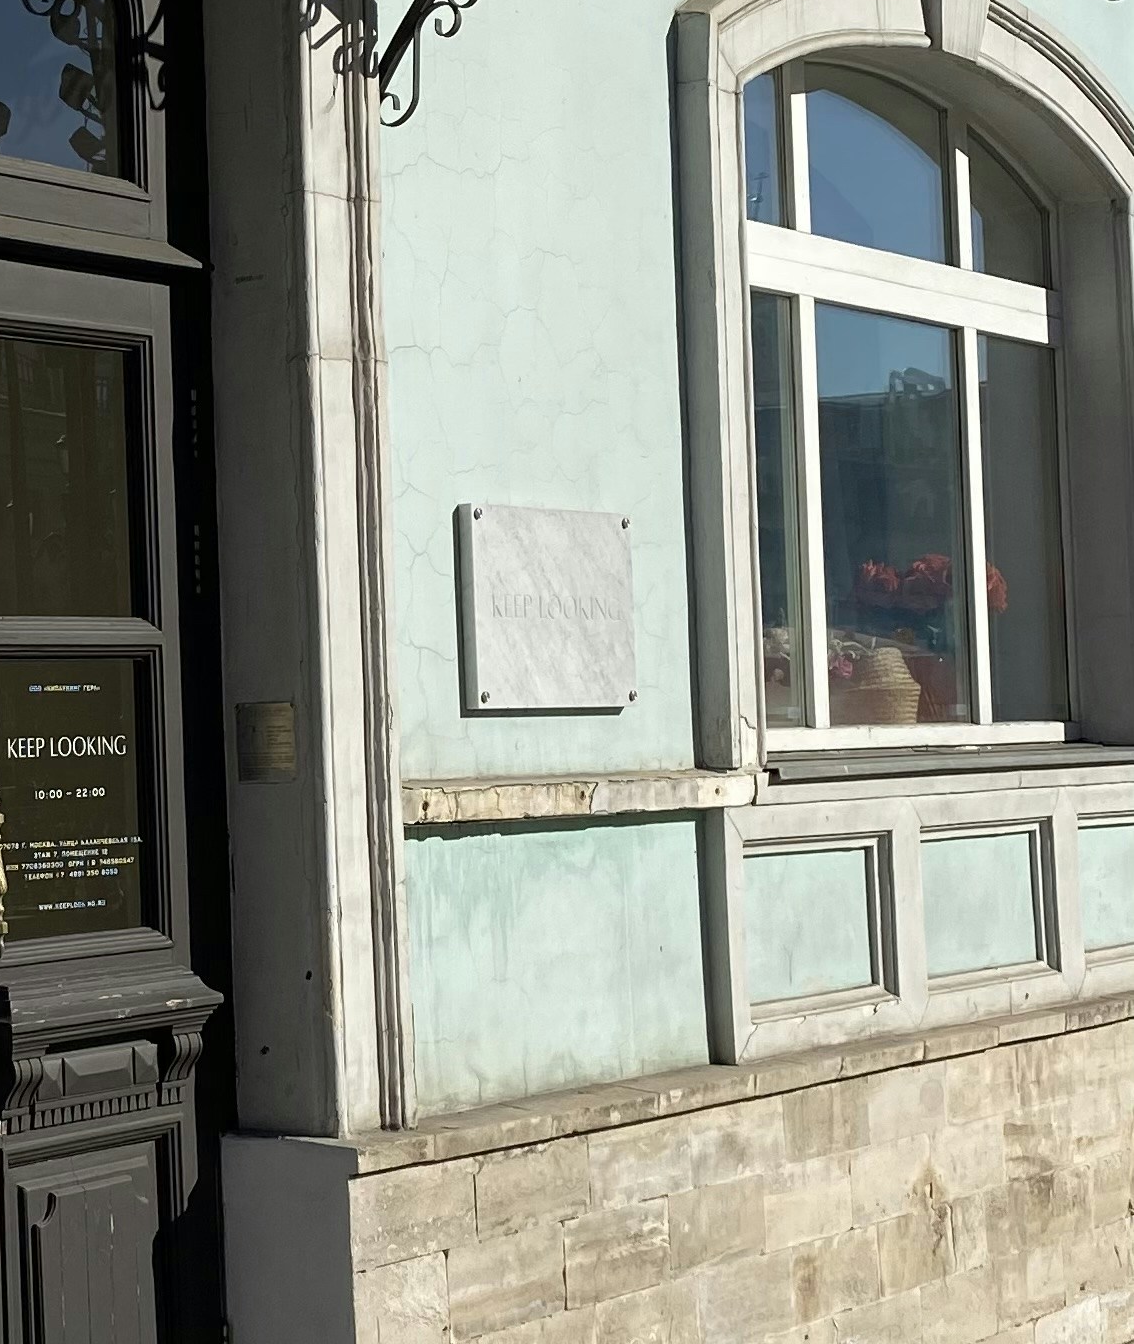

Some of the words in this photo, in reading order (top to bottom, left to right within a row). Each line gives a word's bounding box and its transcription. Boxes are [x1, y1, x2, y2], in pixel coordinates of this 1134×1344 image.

[491, 592, 533, 619] KEEP
[538, 593, 627, 621] LOOKING
[7, 737, 45, 759] KEEP
[49, 735, 127, 757] LOOKING
[34, 789, 63, 800] 10:00
[75, 787, 106, 798] 22:00
